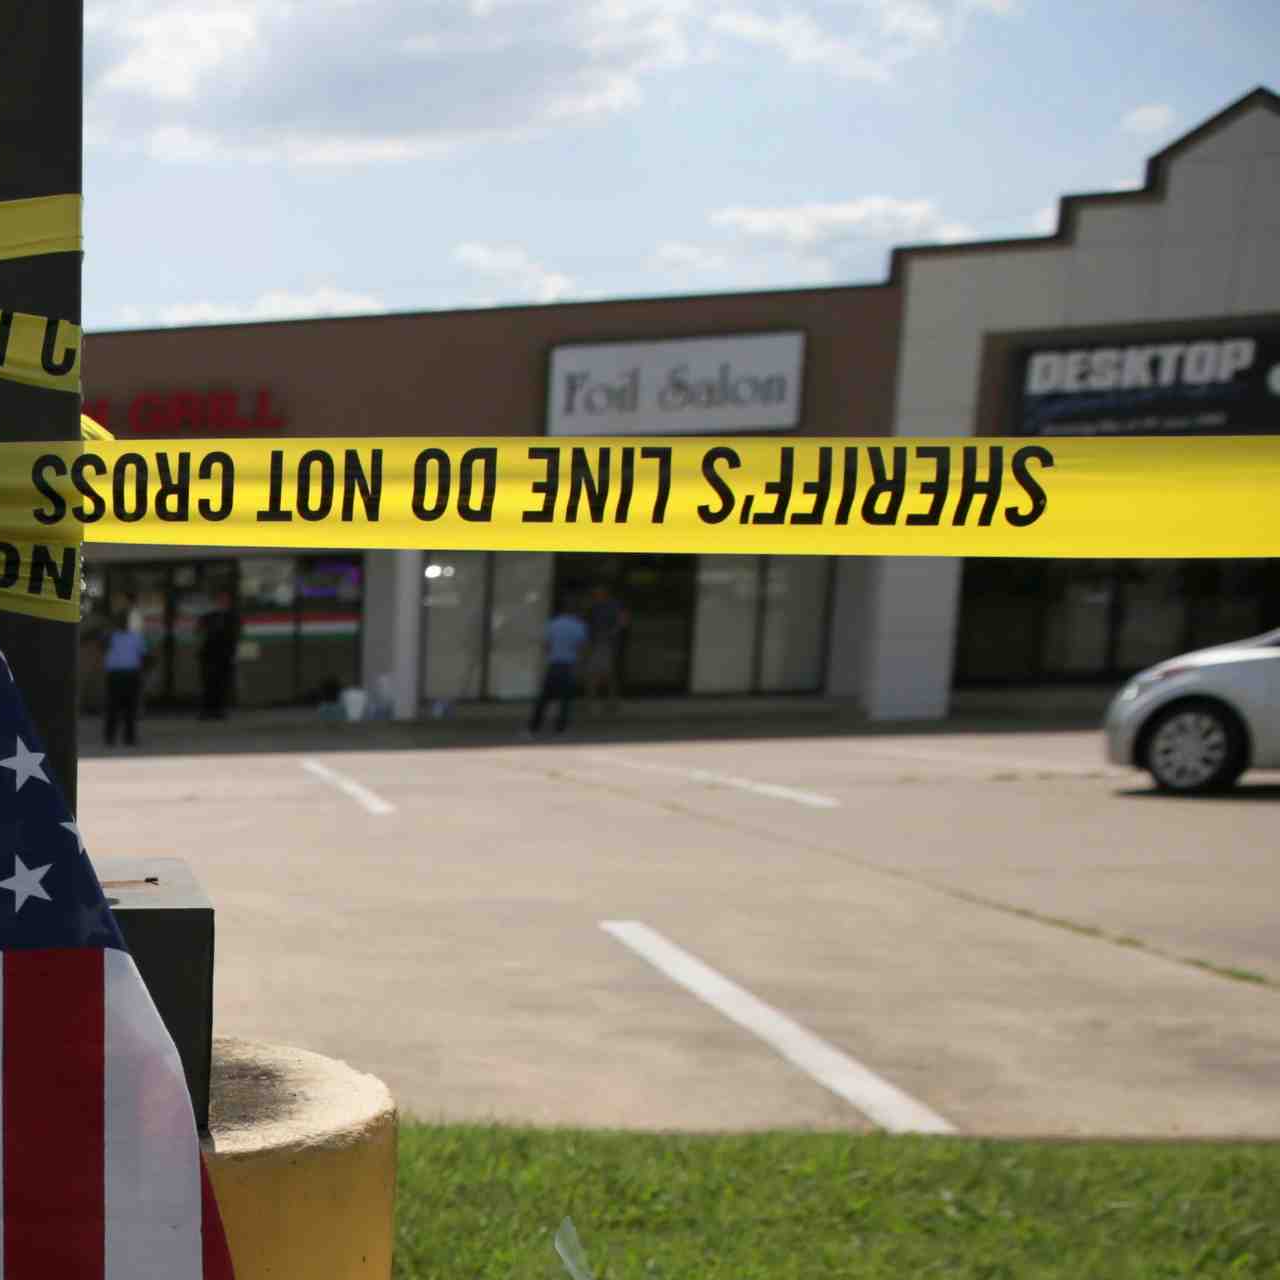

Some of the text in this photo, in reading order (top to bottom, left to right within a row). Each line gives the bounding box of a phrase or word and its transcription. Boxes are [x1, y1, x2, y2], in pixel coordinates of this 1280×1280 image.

[657, 361, 788, 413] Salon
[1027, 337, 1256, 396] DESKTOP
[31, 446, 1055, 528] SHERIFF'S LINE DO NOT CROSS
